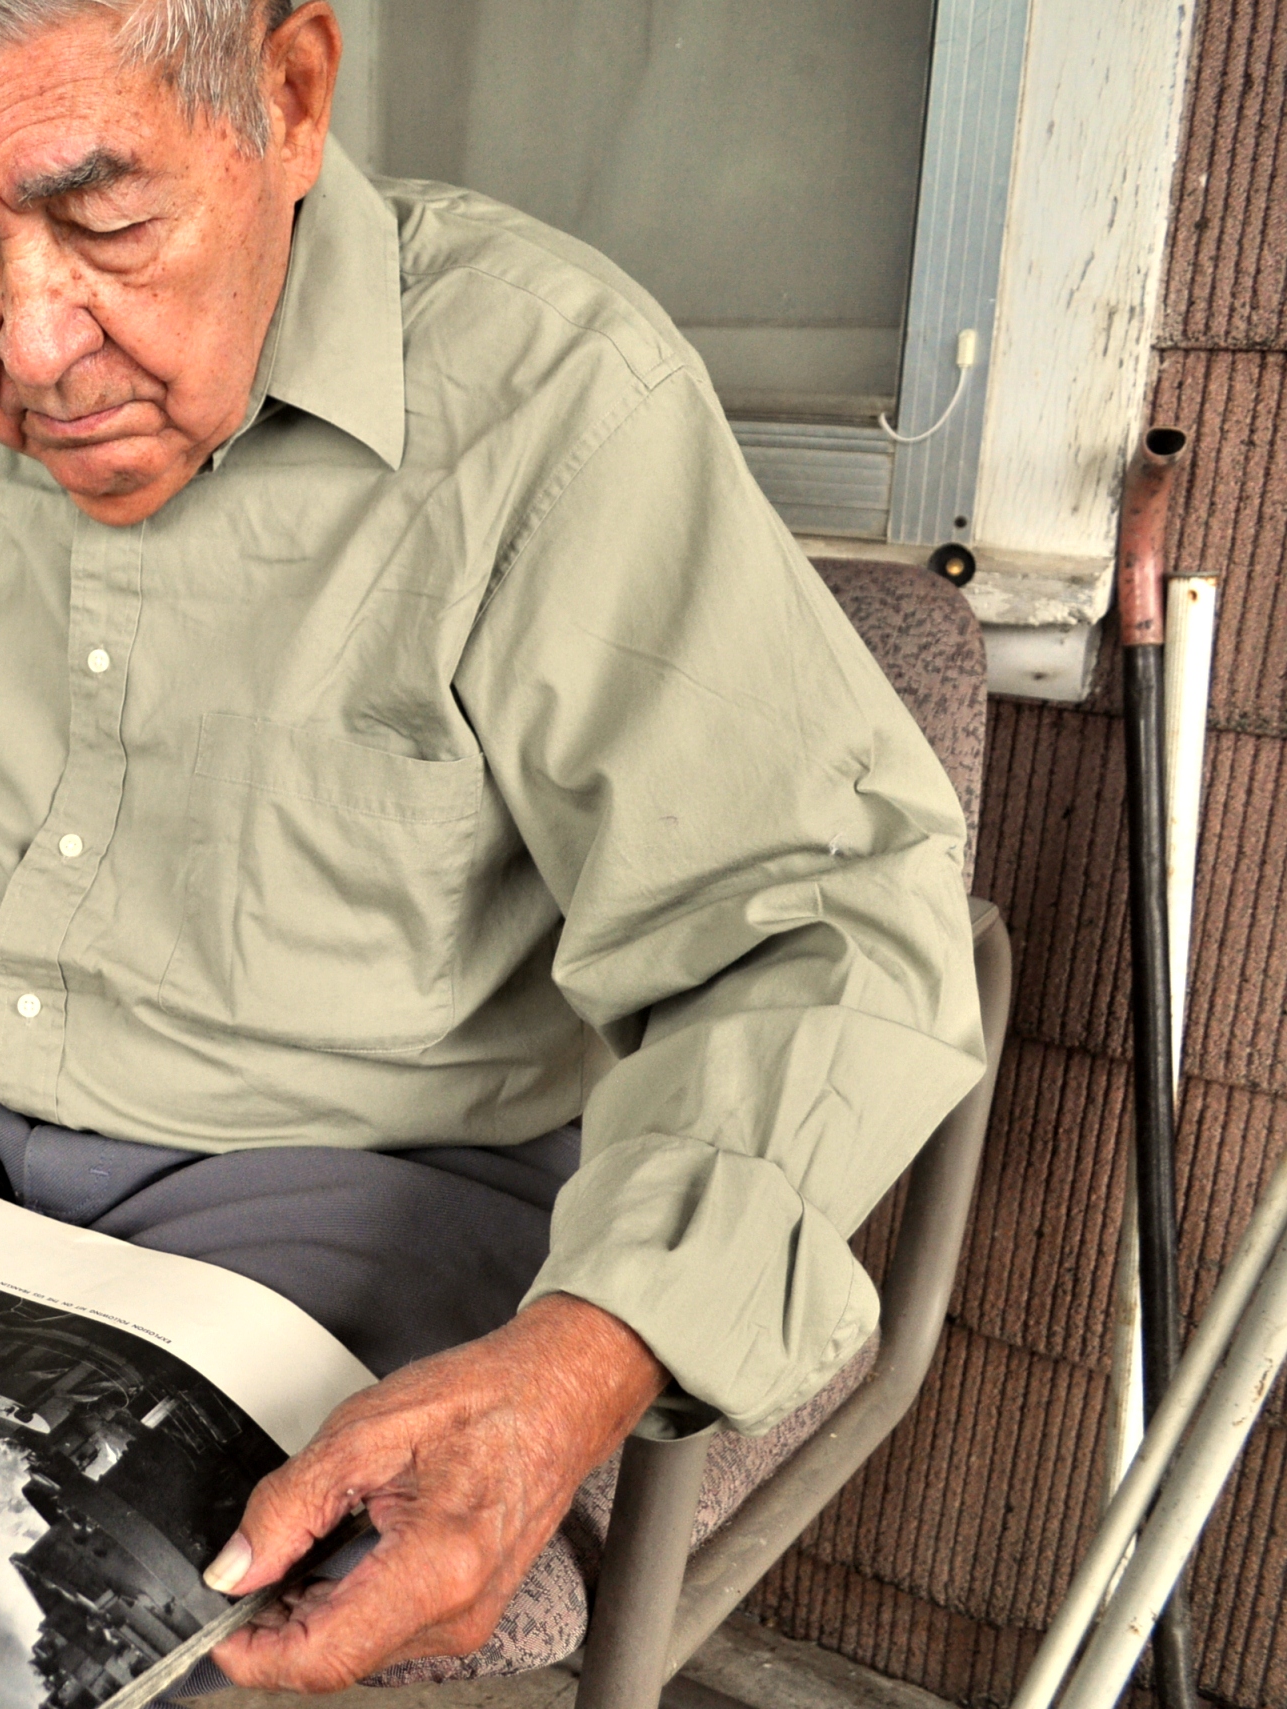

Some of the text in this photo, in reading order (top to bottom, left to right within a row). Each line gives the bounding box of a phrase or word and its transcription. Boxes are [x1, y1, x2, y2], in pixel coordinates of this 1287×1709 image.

[0, 1281, 31, 1294] FRANKLIN
[89, 1309, 130, 1325] FOLLOWING
[131, 1324, 172, 1344] EXPLOSION
